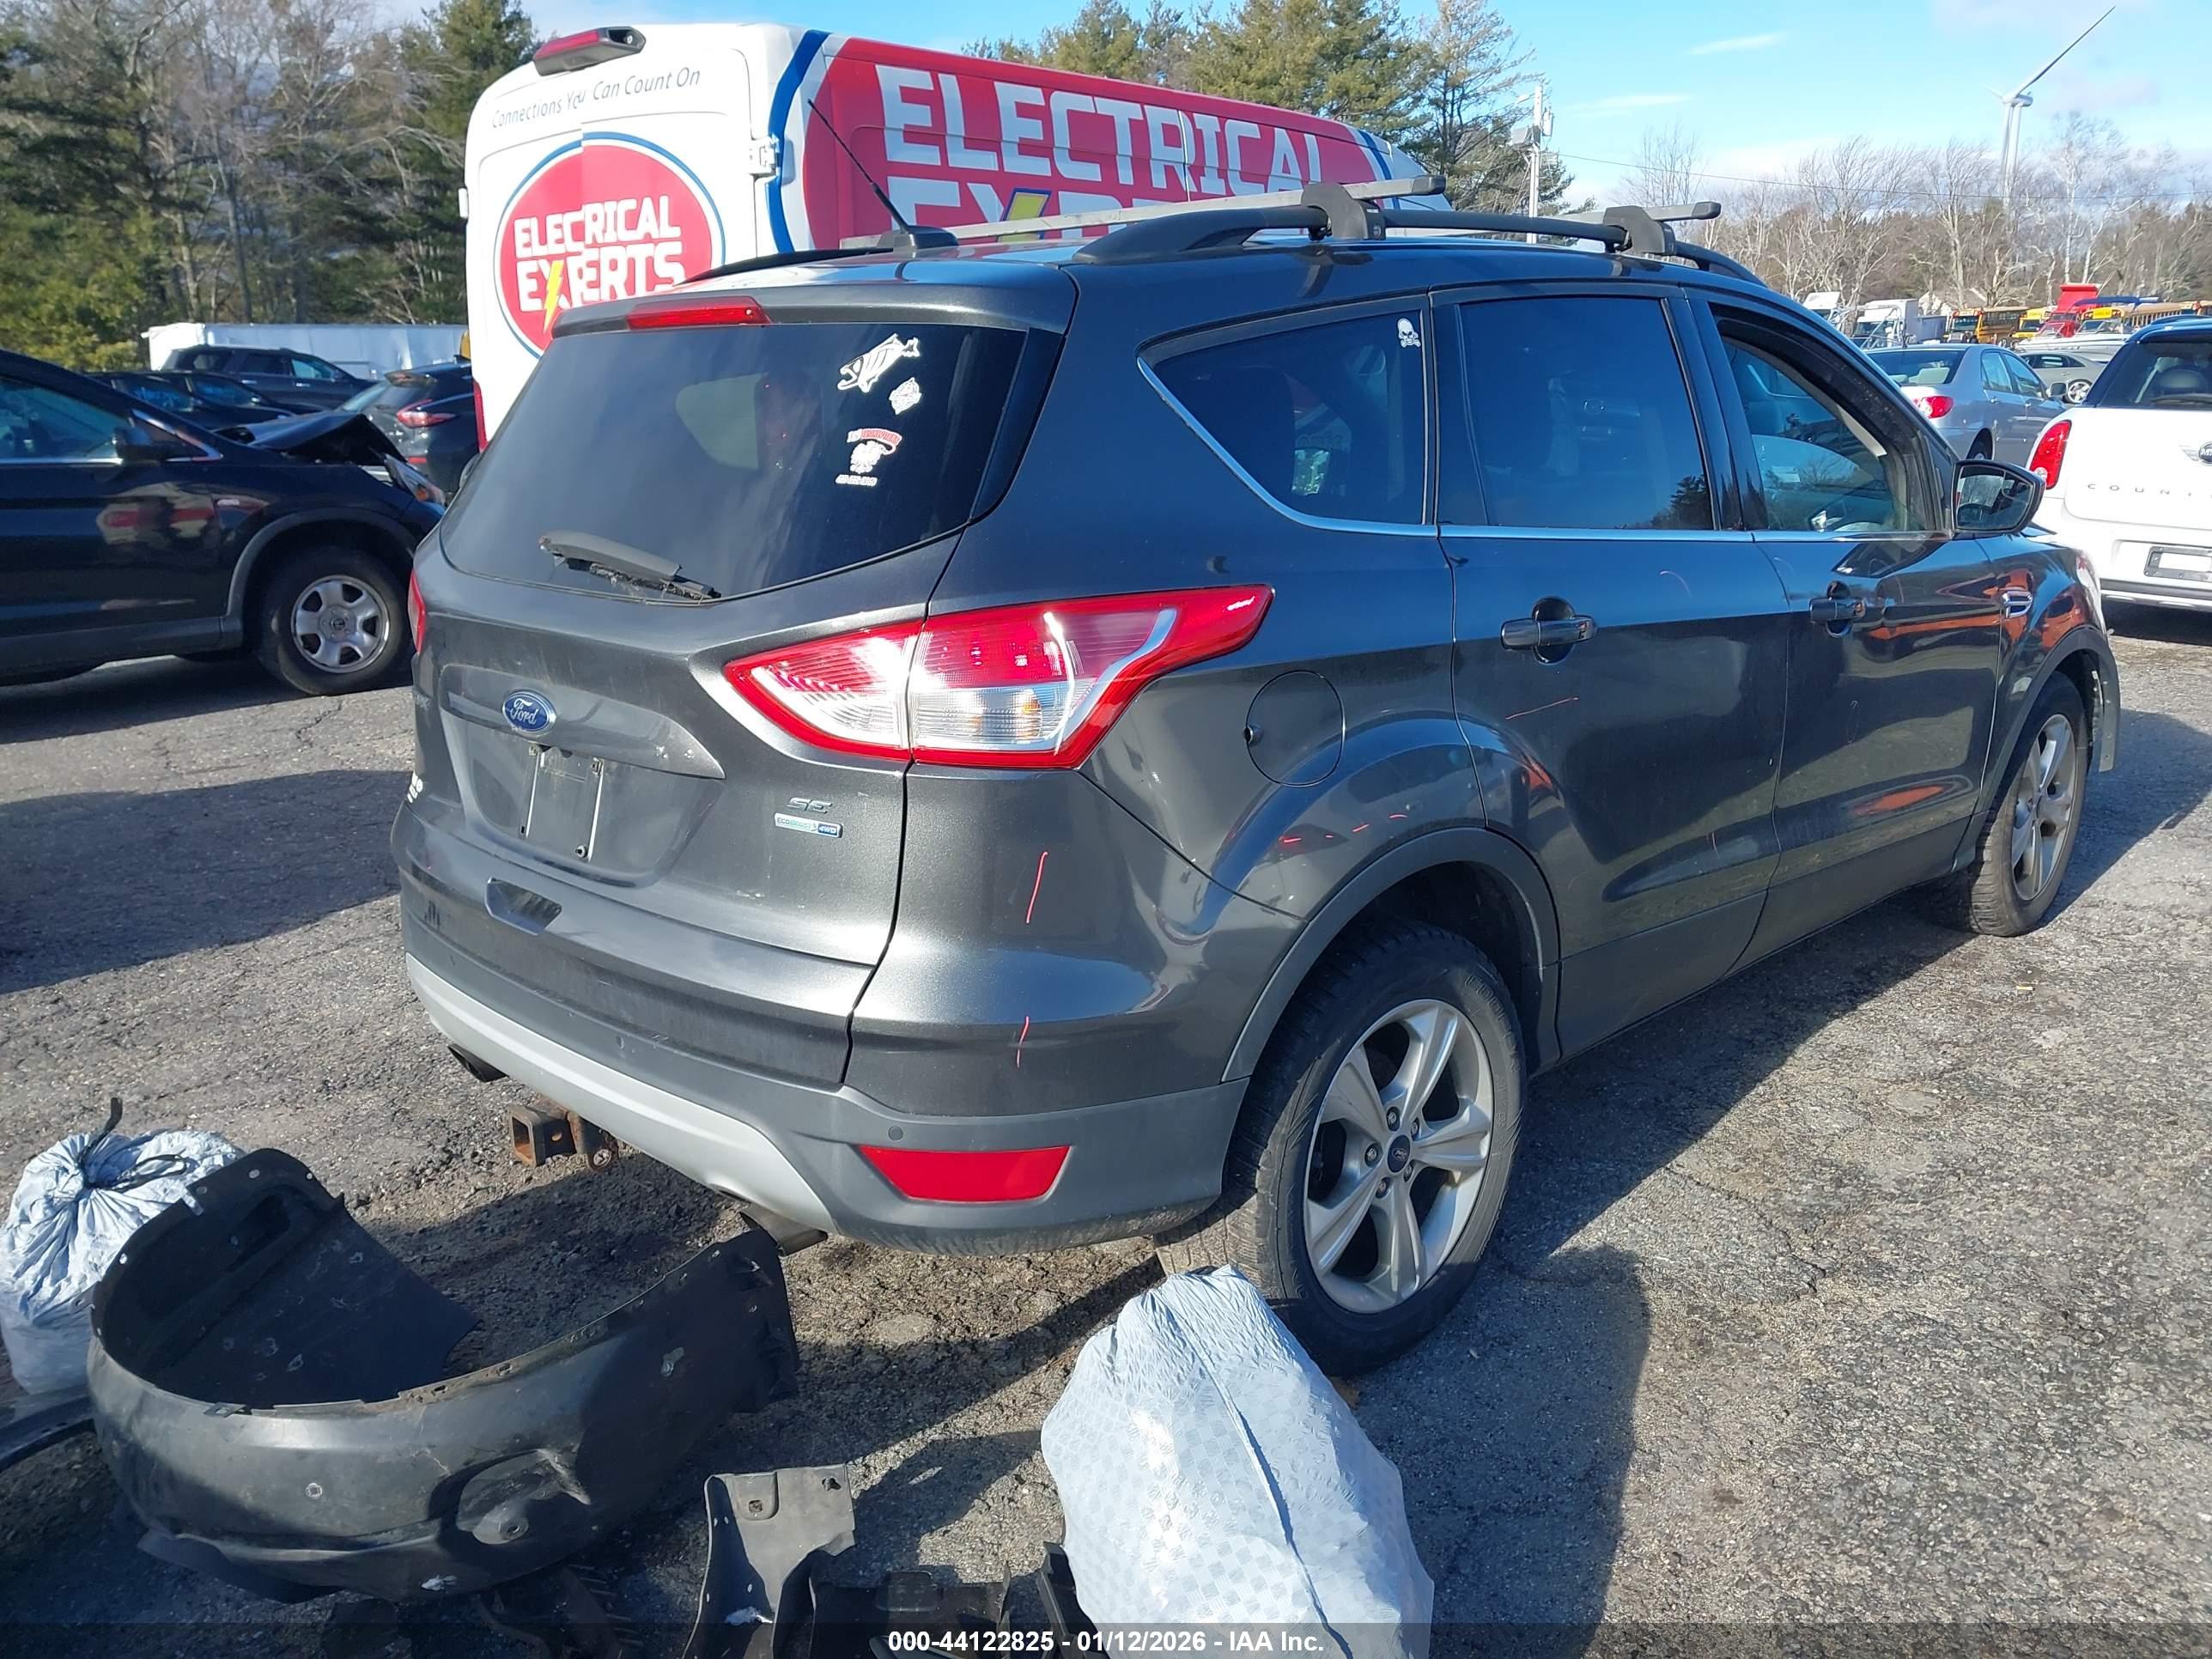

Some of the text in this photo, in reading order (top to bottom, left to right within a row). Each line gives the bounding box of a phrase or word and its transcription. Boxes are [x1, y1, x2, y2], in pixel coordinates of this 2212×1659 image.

[492, 98, 562, 129] Connections
[592, 81, 623, 100] Can
[624, 72, 672, 95] Count
[676, 66, 702, 88] On
[875, 64, 1324, 195] ELECTRICAL
[2087, 483, 2212, 500] COUN
[510, 698, 539, 725] Ford
[787, 797, 833, 815] SE
[818, 825, 837, 835] 4WD
